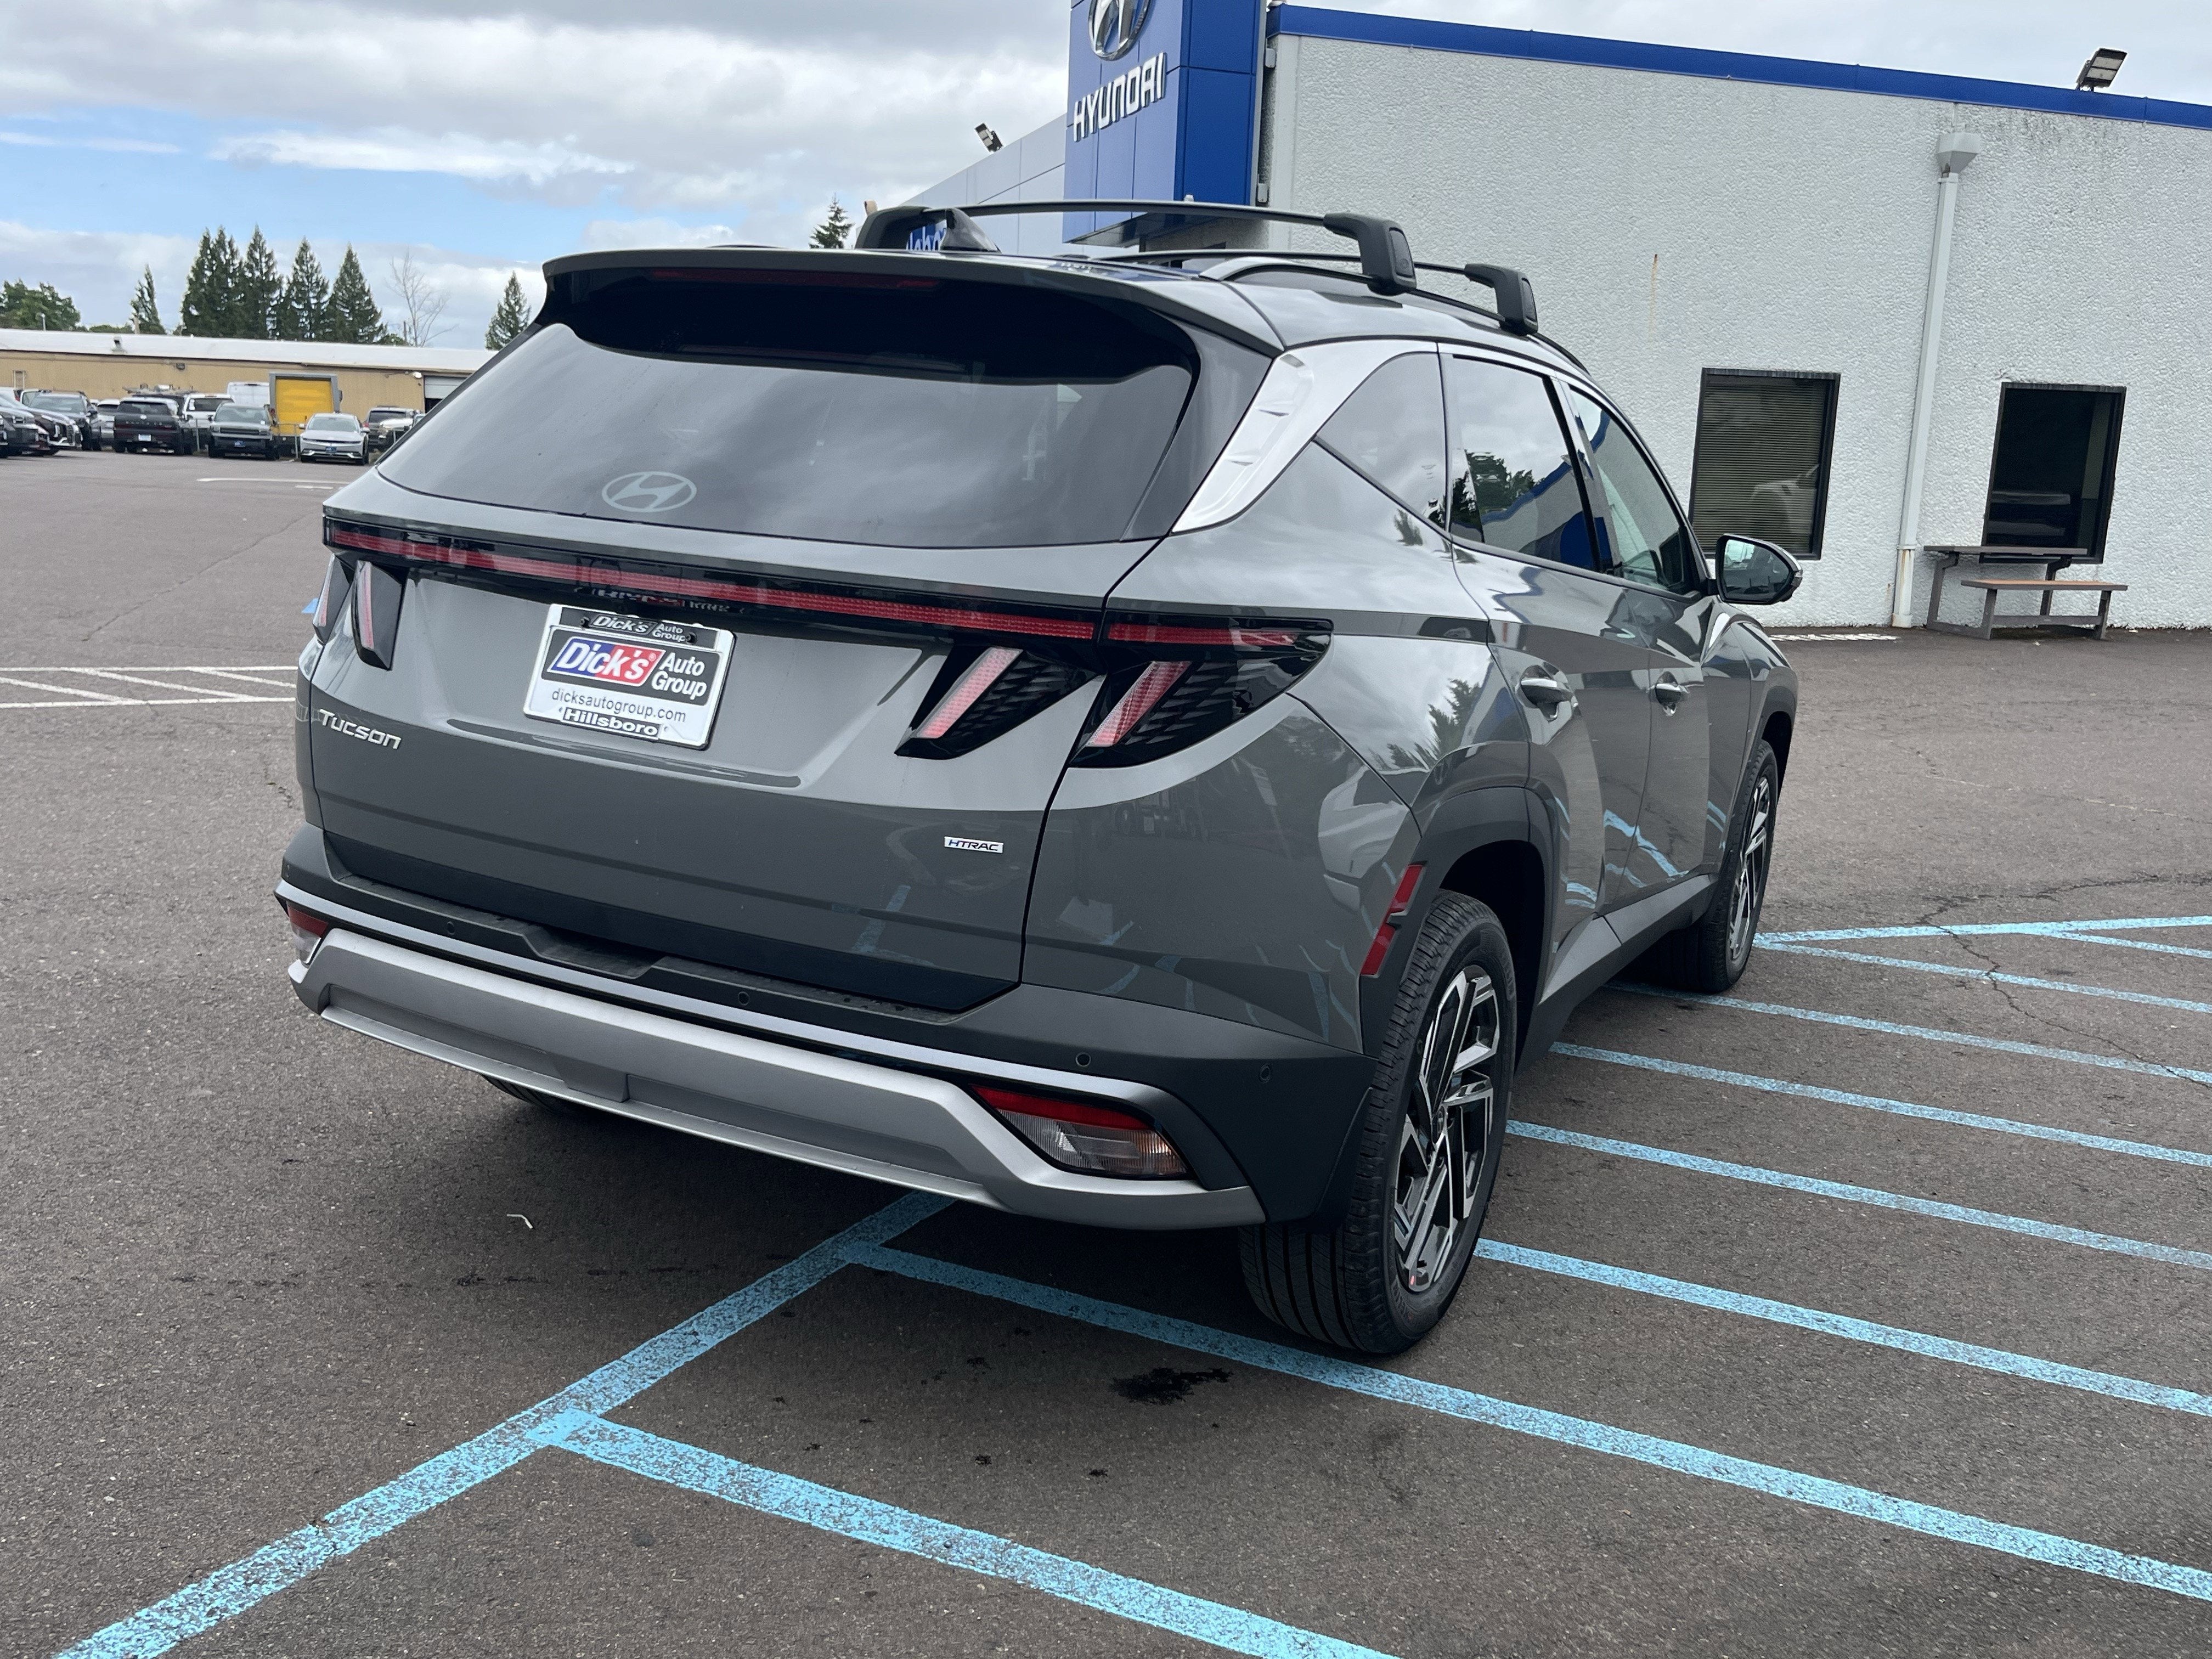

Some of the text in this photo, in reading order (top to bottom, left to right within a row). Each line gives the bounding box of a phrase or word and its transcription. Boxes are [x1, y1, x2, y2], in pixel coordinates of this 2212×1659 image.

[1073, 52, 1167, 143] HYUNDAI
[592, 616, 650, 633] Dick's
[652, 630, 686, 642] Group
[658, 623, 684, 634] Auto
[658, 652, 706, 676] Auto
[651, 670, 707, 700] Group
[552, 688, 686, 723] dicksautogroup.com
[563, 708, 658, 736] Hillsboro
[948, 839, 999, 851] HTRAC
